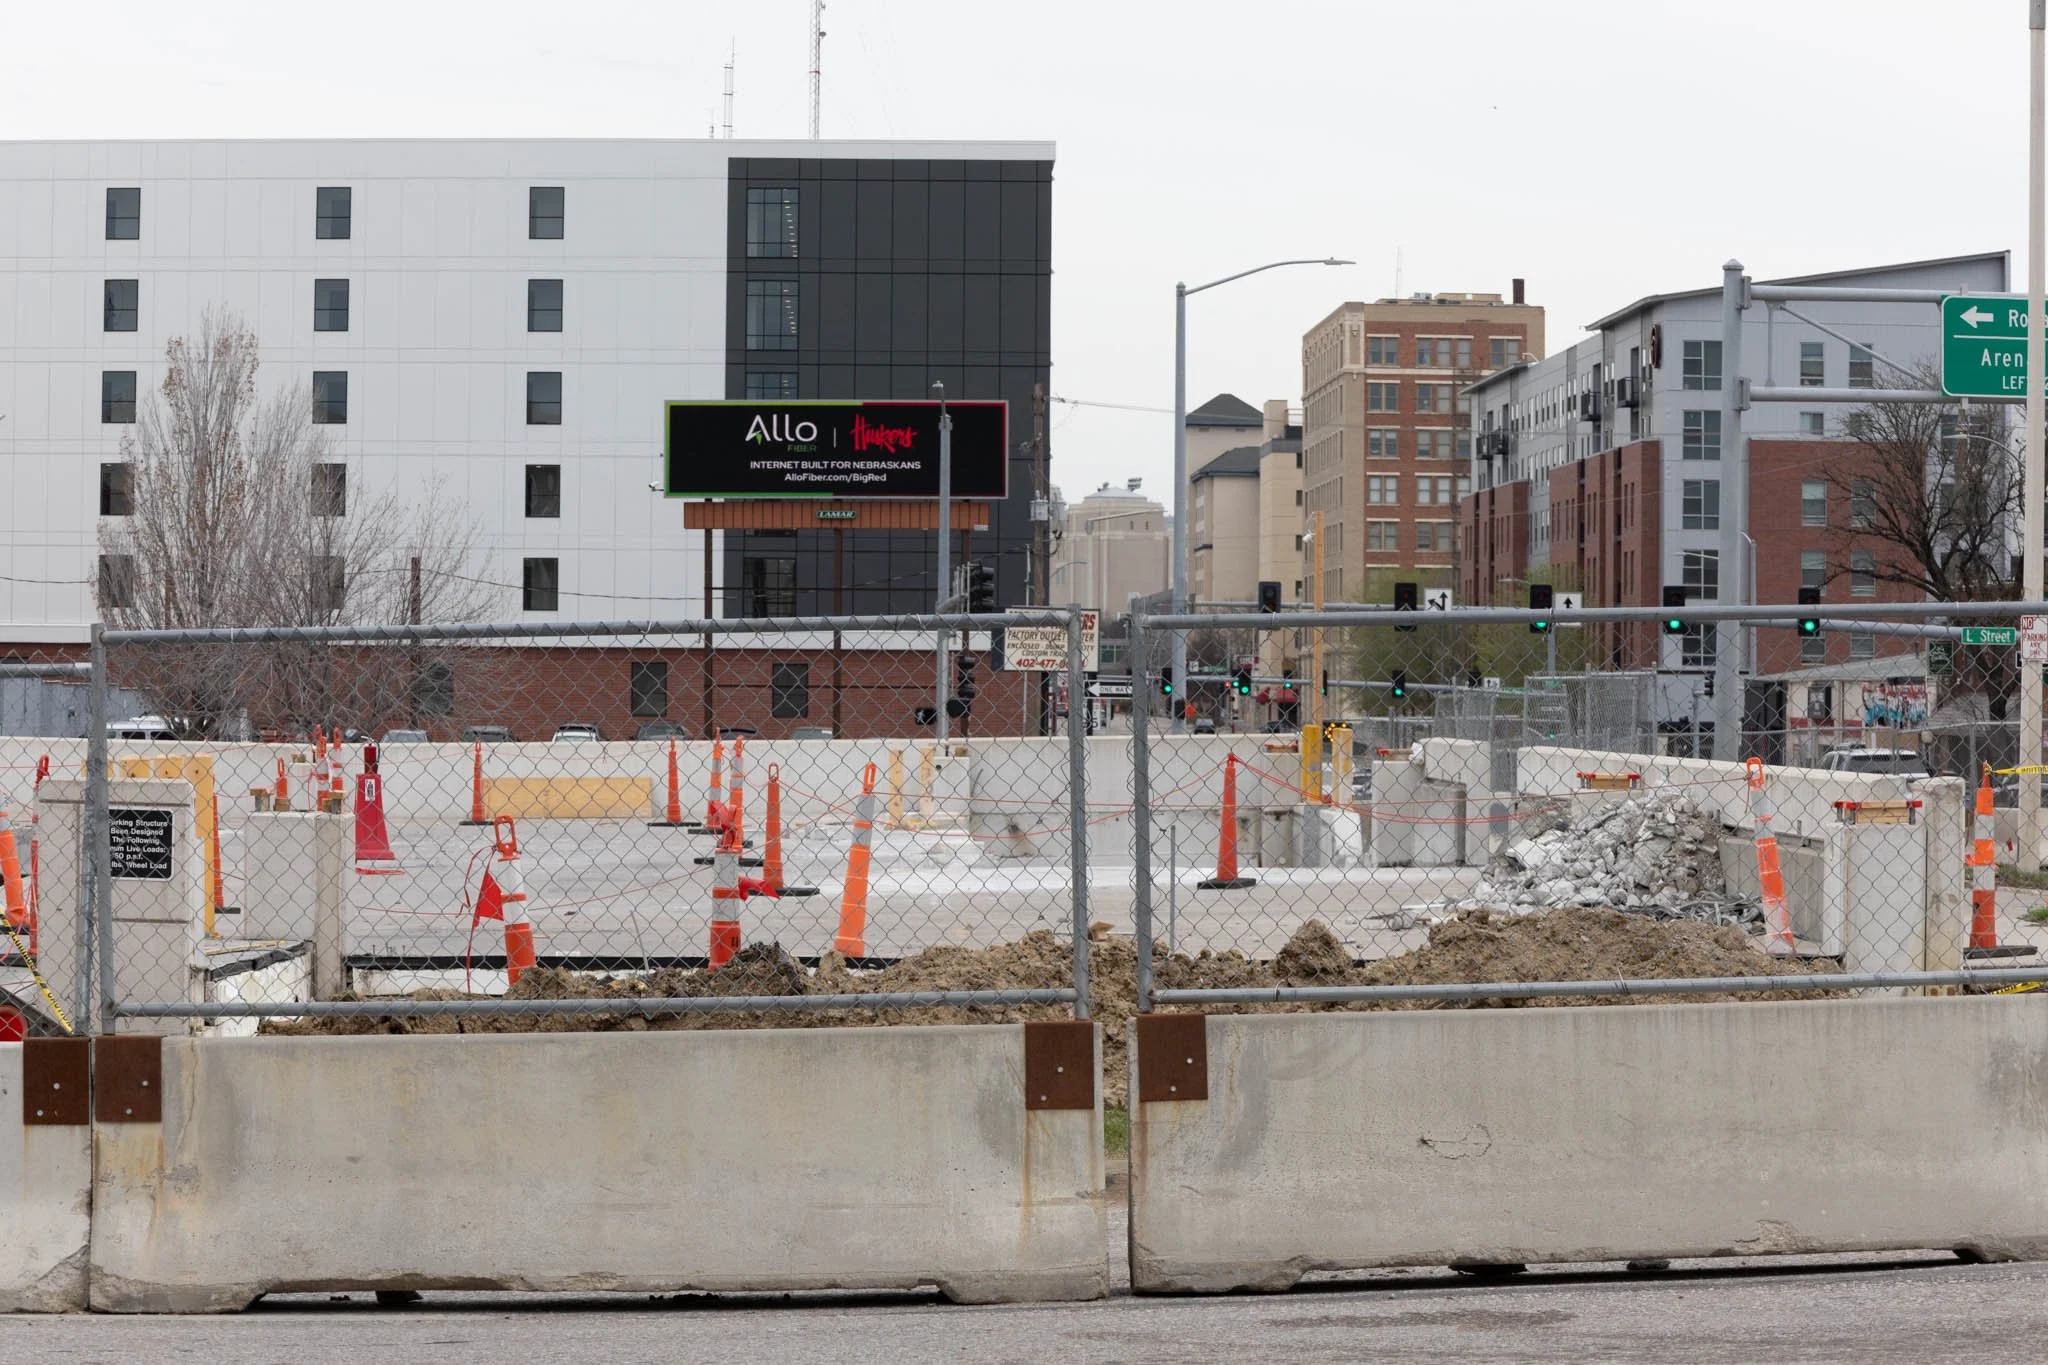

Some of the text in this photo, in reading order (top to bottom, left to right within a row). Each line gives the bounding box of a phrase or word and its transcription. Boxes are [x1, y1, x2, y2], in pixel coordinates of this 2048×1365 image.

[1981, 348, 2023, 367] Aren
[2002, 375, 2028, 389] LEF
[745, 413, 918, 454] Allo Huskers
[787, 444, 817, 452] FIBER
[750, 461, 921, 469] INTERNET BUILT FOR NEBRASKANS
[784, 473, 887, 483] AlloFiber.com/BigRed
[2023, 617, 2033, 629] NO
[1008, 630, 1038, 640] FACTORY
[1039, 630, 1066, 641] OUTLET
[1966, 629, 2011, 642] L Street
